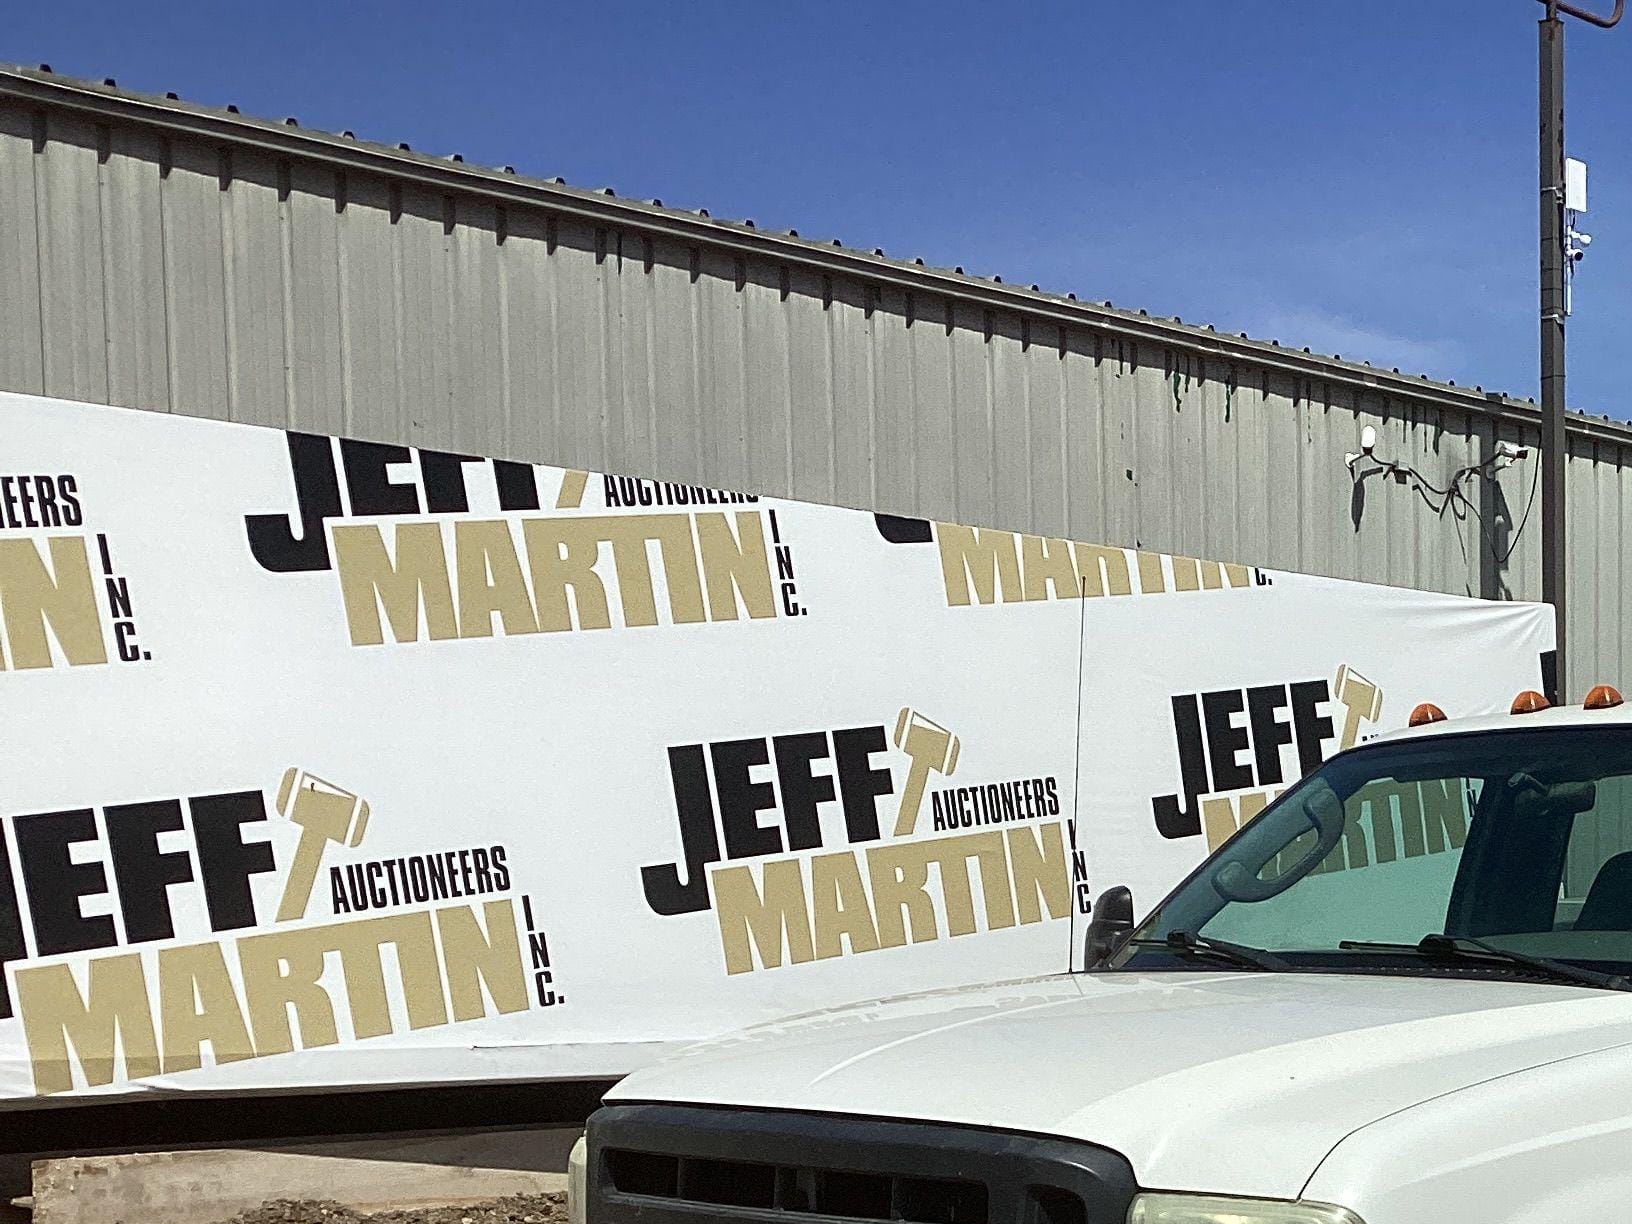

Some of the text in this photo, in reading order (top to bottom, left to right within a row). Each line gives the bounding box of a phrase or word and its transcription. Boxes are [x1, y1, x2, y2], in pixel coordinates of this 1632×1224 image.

[0, 474, 83, 528] EERS
[331, 510, 777, 647] MARTIN
[640, 725, 894, 916] JEFF
[931, 776, 1060, 832] AUCTIONEERS
[1152, 680, 1335, 839] JEFF
[330, 845, 511, 914] AUCTIONEERS
[711, 820, 1073, 976] MARTIN
[14, 898, 530, 1097] MARTIN
